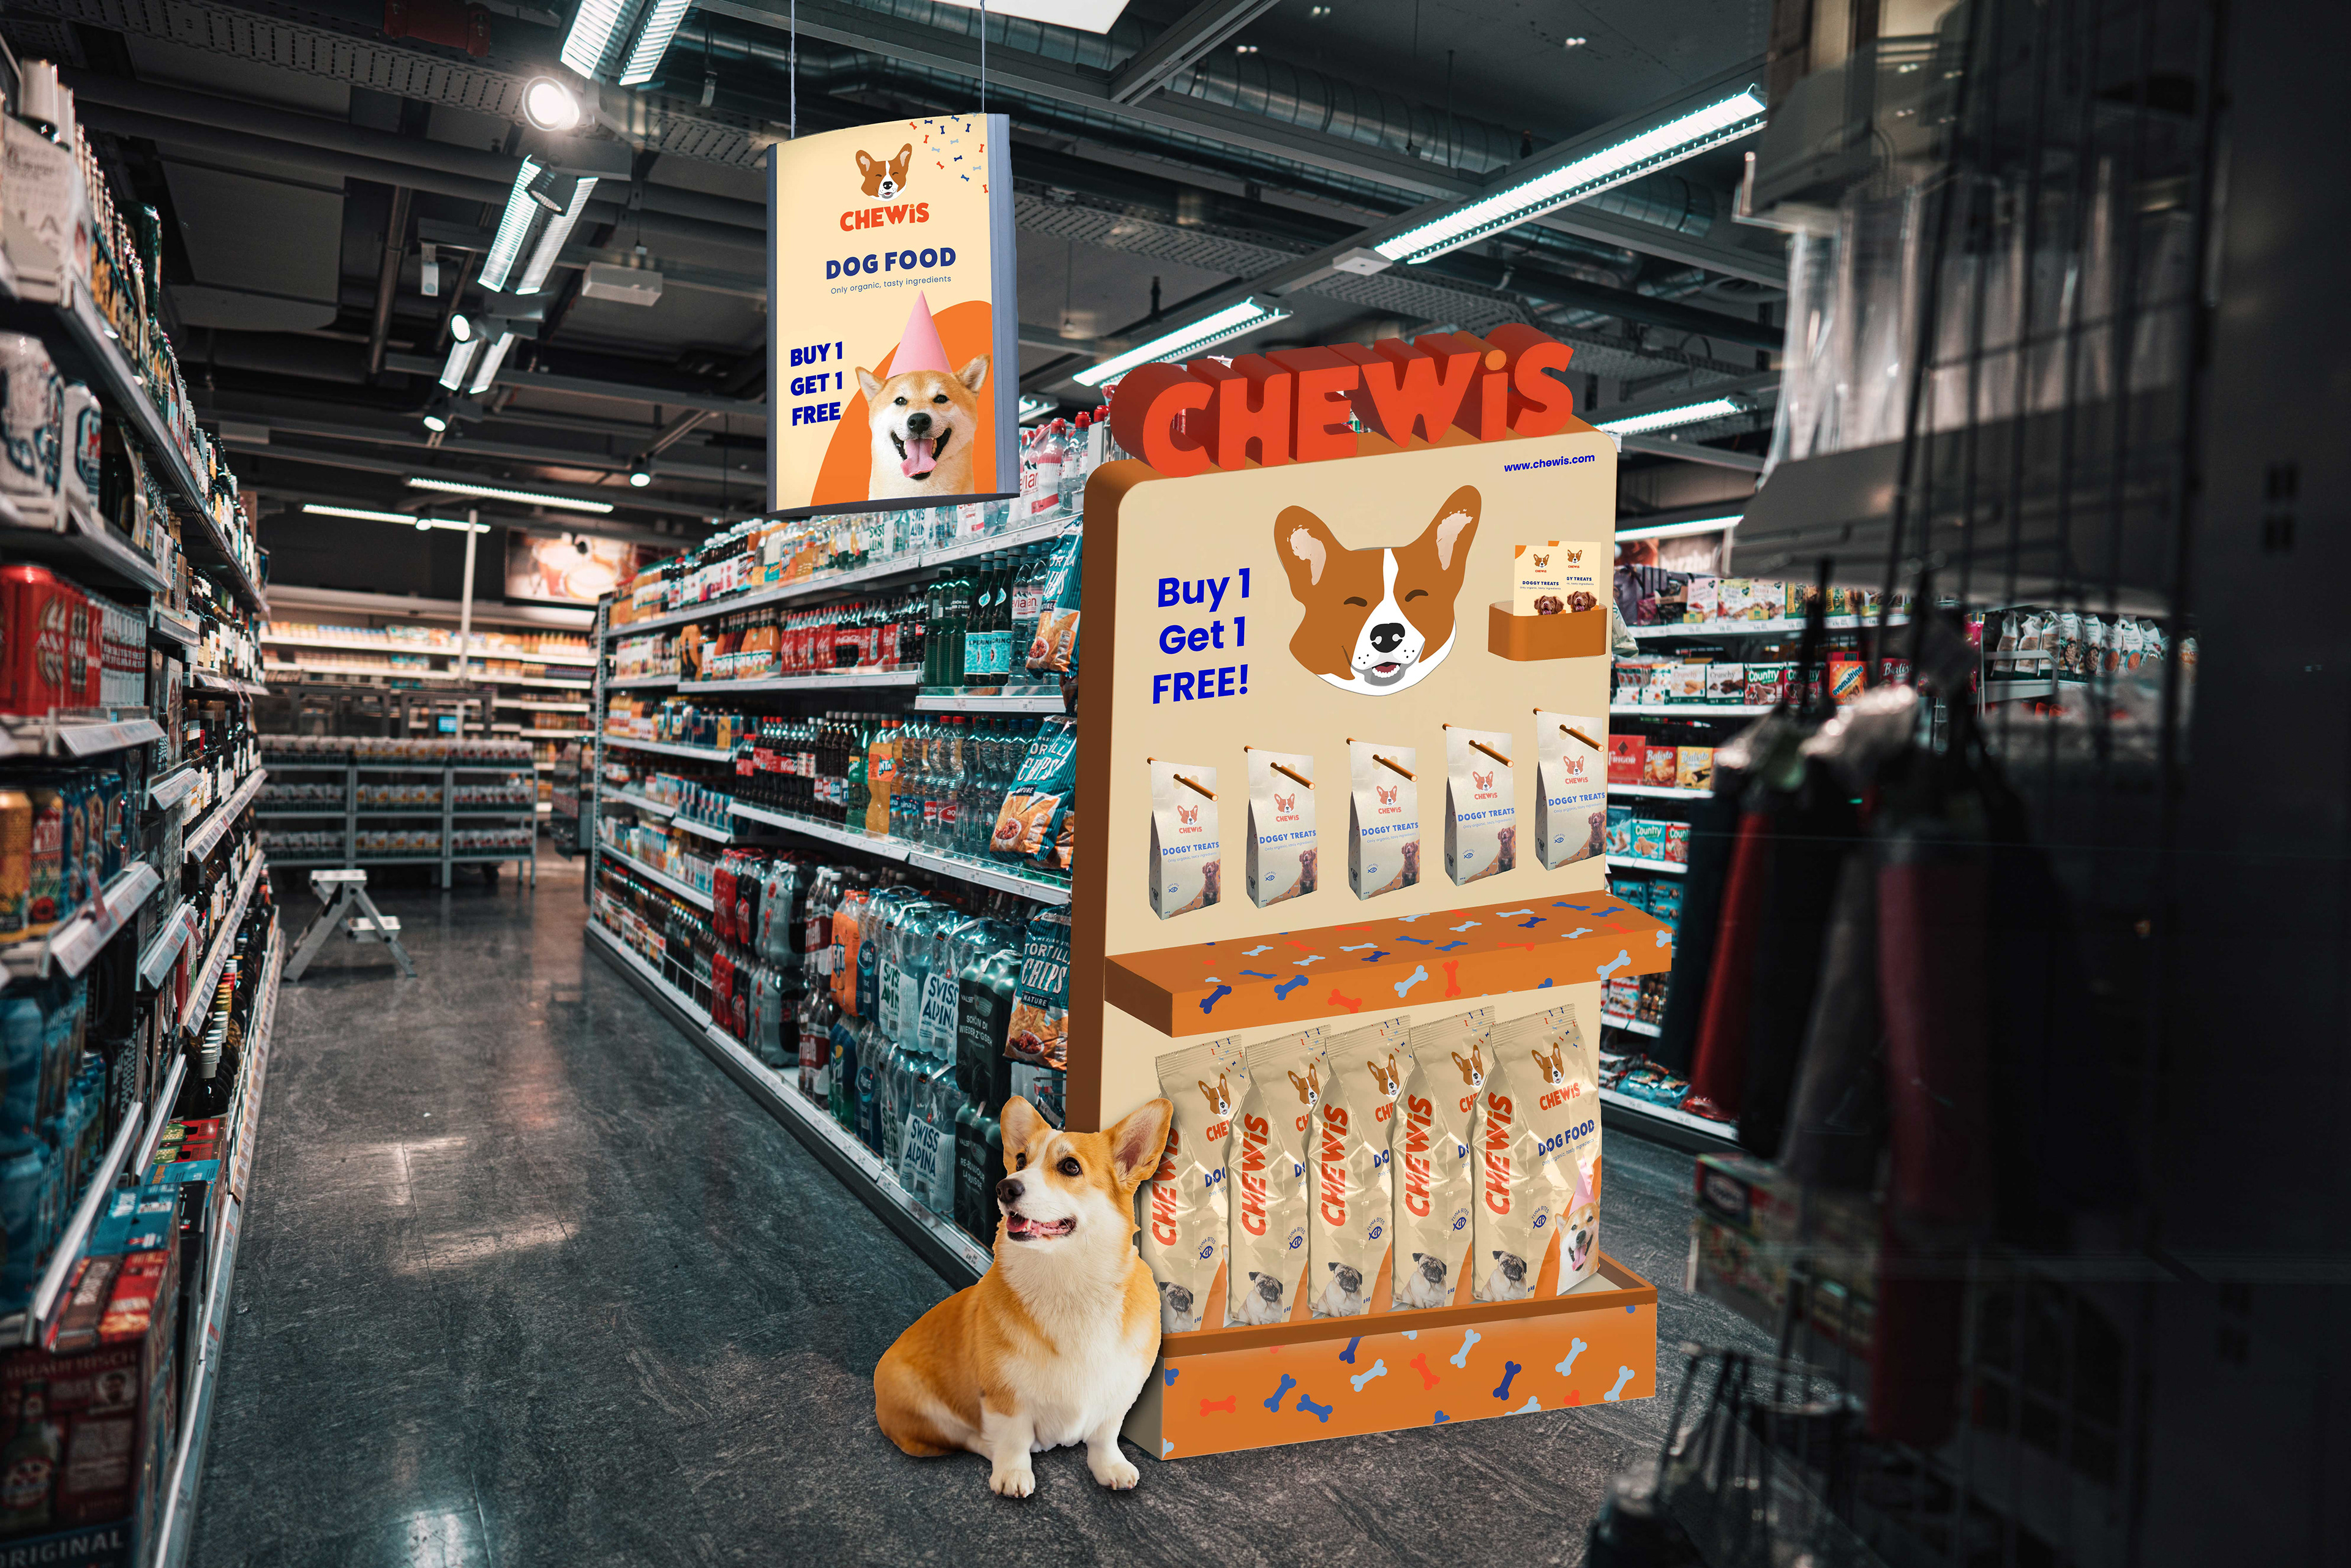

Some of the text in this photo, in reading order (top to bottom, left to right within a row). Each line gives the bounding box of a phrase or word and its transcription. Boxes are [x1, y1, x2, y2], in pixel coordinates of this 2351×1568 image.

[826, 247, 956, 280] DOG FOOD
[850, 282, 882, 292] organic,
[906, 276, 951, 286] ingredients
[790, 341, 843, 367] BUY 1
[790, 371, 843, 396] GET 1
[792, 401, 841, 426] FREE
[1504, 454, 1595, 472] www.chewis.com
[1157, 568, 1251, 613] Buy 1
[1158, 617, 1245, 655] Get 1
[1710, 671, 1736, 680] Crunchy
[1749, 670, 1779, 684] Country
[1832, 666, 1864, 696] ovomaltine
[1152, 664, 1249, 705] FREE!
[1608, 749, 1636, 765] FRIGOR
[1646, 750, 1673, 762] Balisto
[1681, 751, 1709, 763] Balisto
[1548, 792, 1605, 806] DOGGY TREATS
[1458, 808, 1515, 822] DOGGY TREATS
[1362, 822, 1419, 836] DOGGY TREATS
[1635, 825, 1662, 838] Country
[1259, 830, 1316, 844] DOGGY TREATS
[1163, 842, 1219, 856] DOGGY TREATS
[1021, 958, 1068, 994] CHIPS
[928, 976, 959, 1008] SWISS
[961, 994, 973, 1003] VALSER
[1023, 994, 1048, 1007] NATURE
[966, 1015, 988, 1031] SCHÖN DI
[959, 1024, 975, 1038] WIEDER
[910, 1118, 940, 1153] SWISS
[1538, 1119, 1595, 1157] DOG FOOD
[1575, 1138, 1595, 1150] ingredients
[905, 1141, 936, 1177] ALPINA
[1451, 1207, 1469, 1221] TUNA BITES
[1531, 1205, 1550, 1220] TUNA BITES
[1367, 1217, 1385, 1231] TUNA BITES
[1288, 1226, 1306, 1240] TUNA BITES
[1198, 1236, 1216, 1251] TUNA BITES
